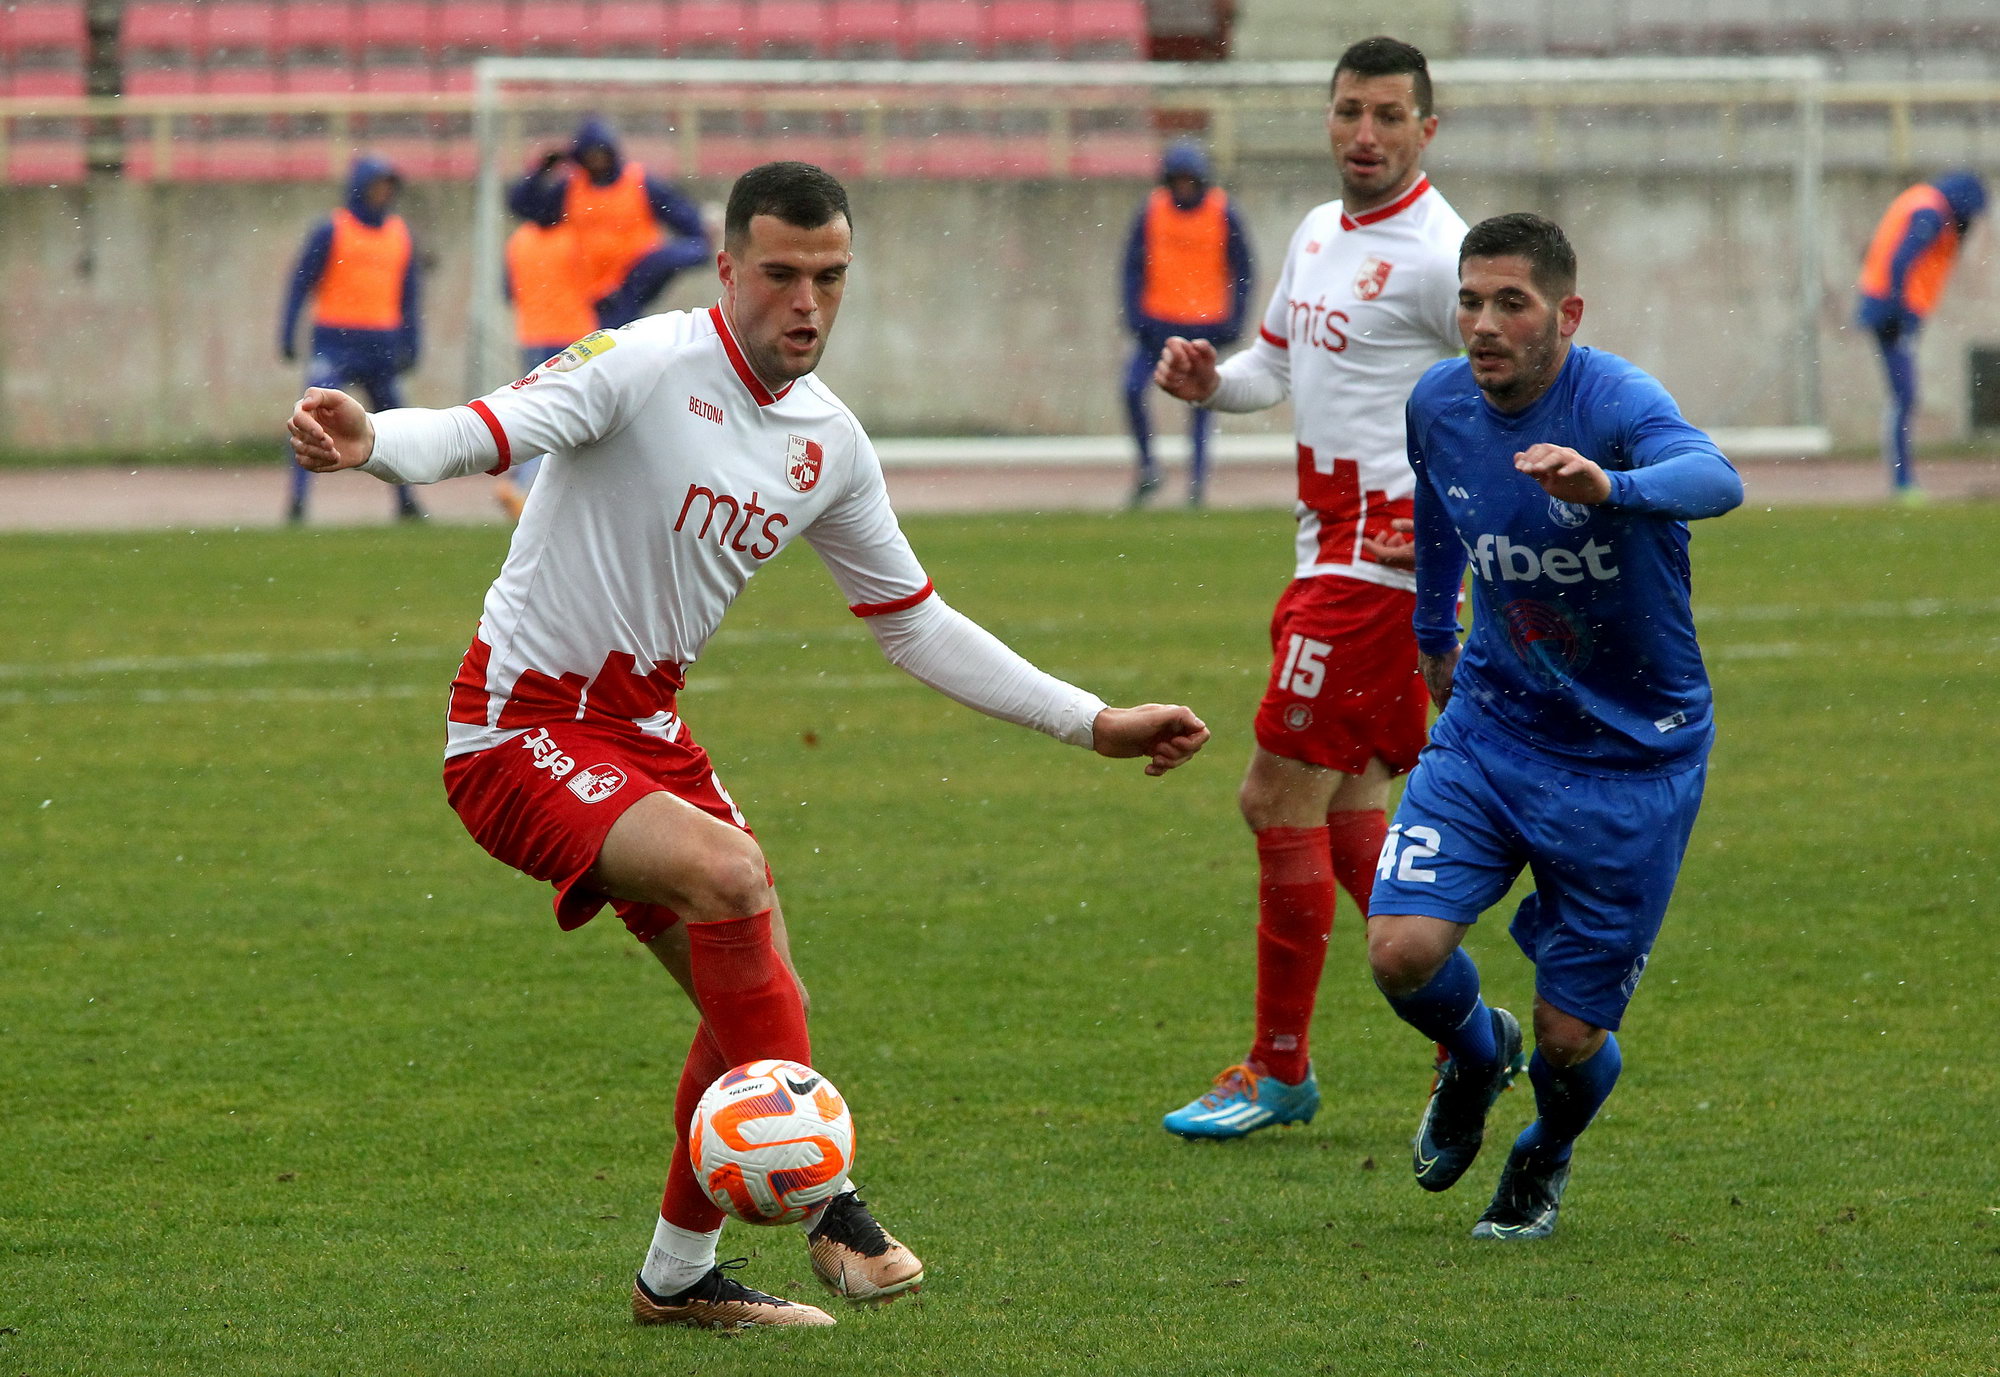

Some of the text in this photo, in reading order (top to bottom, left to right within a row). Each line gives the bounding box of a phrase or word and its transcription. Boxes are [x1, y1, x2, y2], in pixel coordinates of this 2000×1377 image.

[1288, 295, 1350, 353] mts
[689, 395, 723, 426] BELTONA
[791, 437, 805, 447] 1923
[673, 483, 789, 560] mts
[1460, 531, 1620, 585] fbet
[1278, 633, 1334, 699] 15
[1377, 823, 1441, 883] 42
